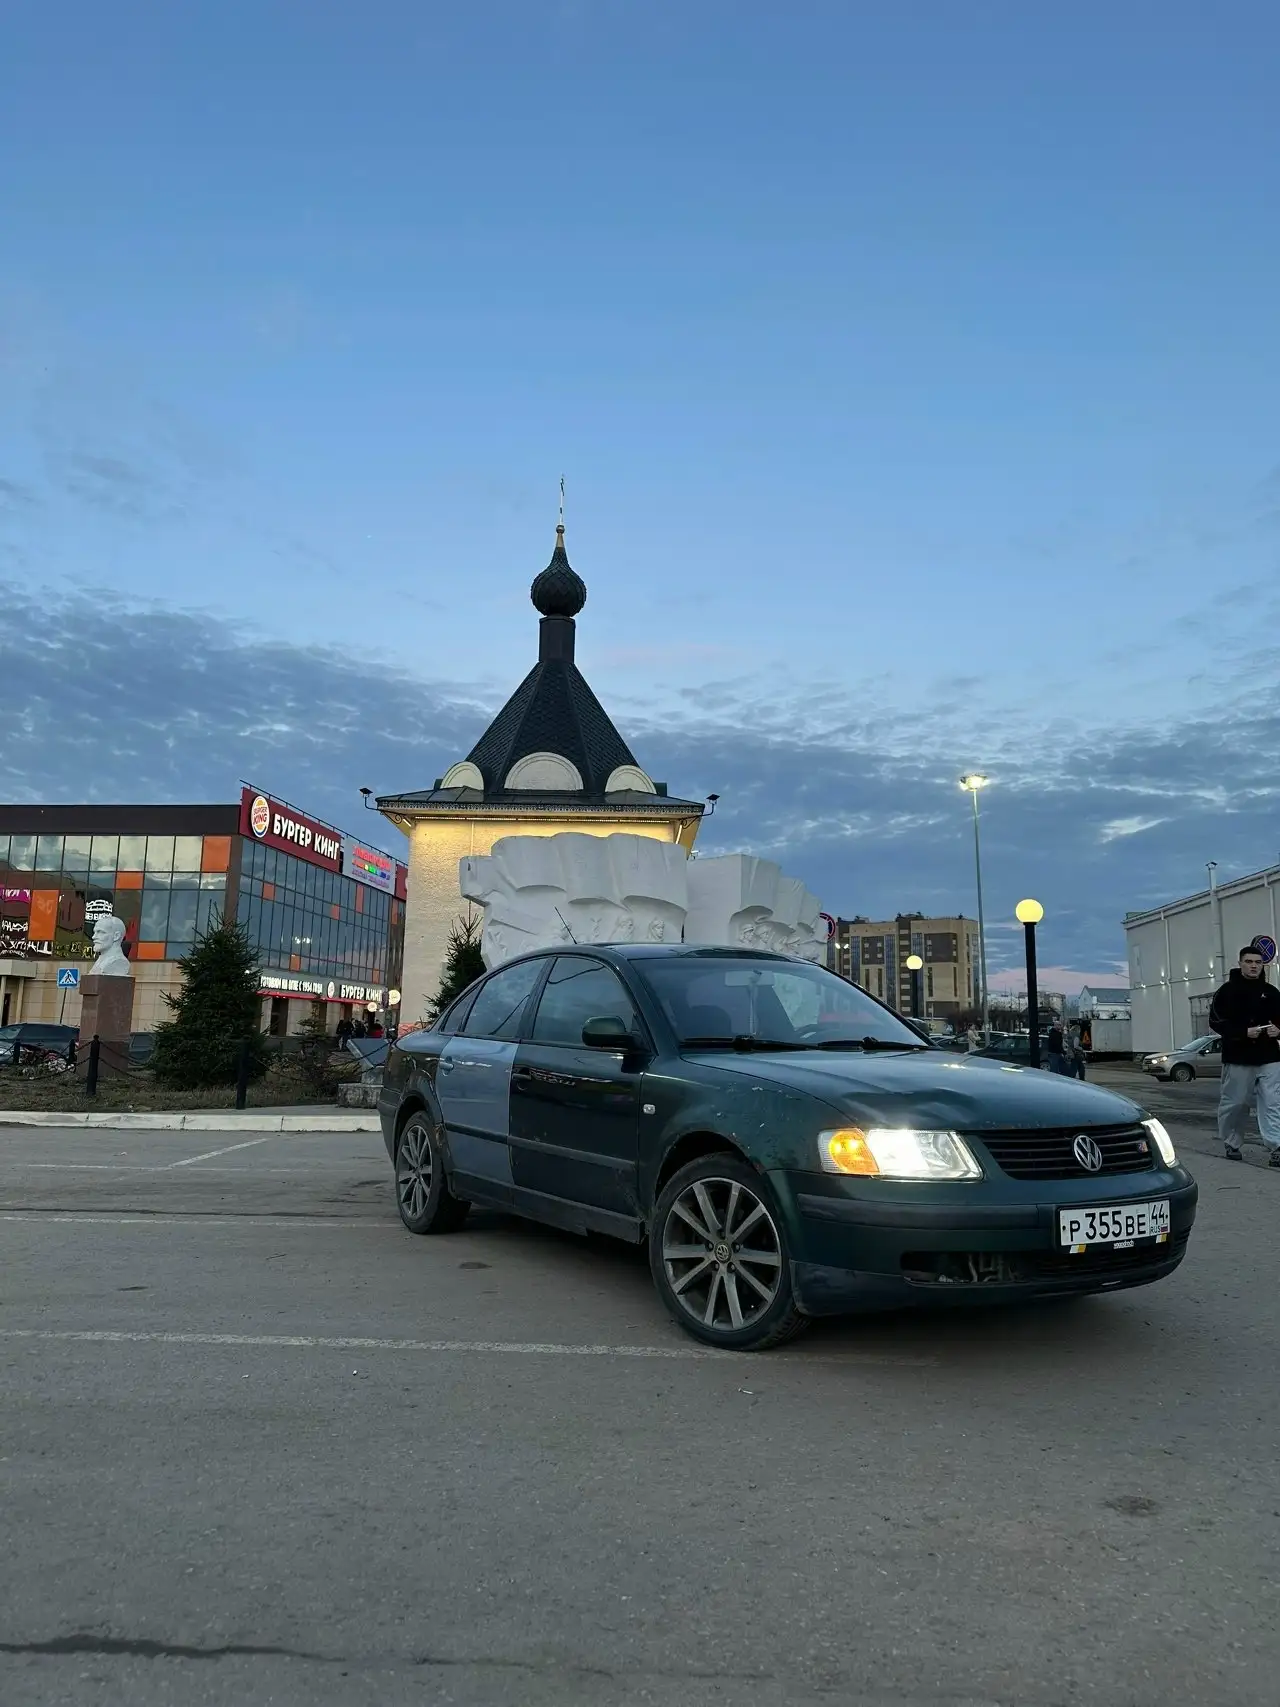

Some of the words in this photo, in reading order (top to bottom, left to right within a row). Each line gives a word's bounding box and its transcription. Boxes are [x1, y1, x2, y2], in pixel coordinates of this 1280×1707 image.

[253, 814, 268, 825] KING
[273, 813, 312, 847] БУРГЕР
[314, 832, 340, 860] КИНГ
[341, 984, 365, 1000] БУРГЕР
[366, 988, 383, 1002] КИНГ
[1151, 1203, 1165, 1225] 44
[1150, 1226, 1161, 1234] RUS
